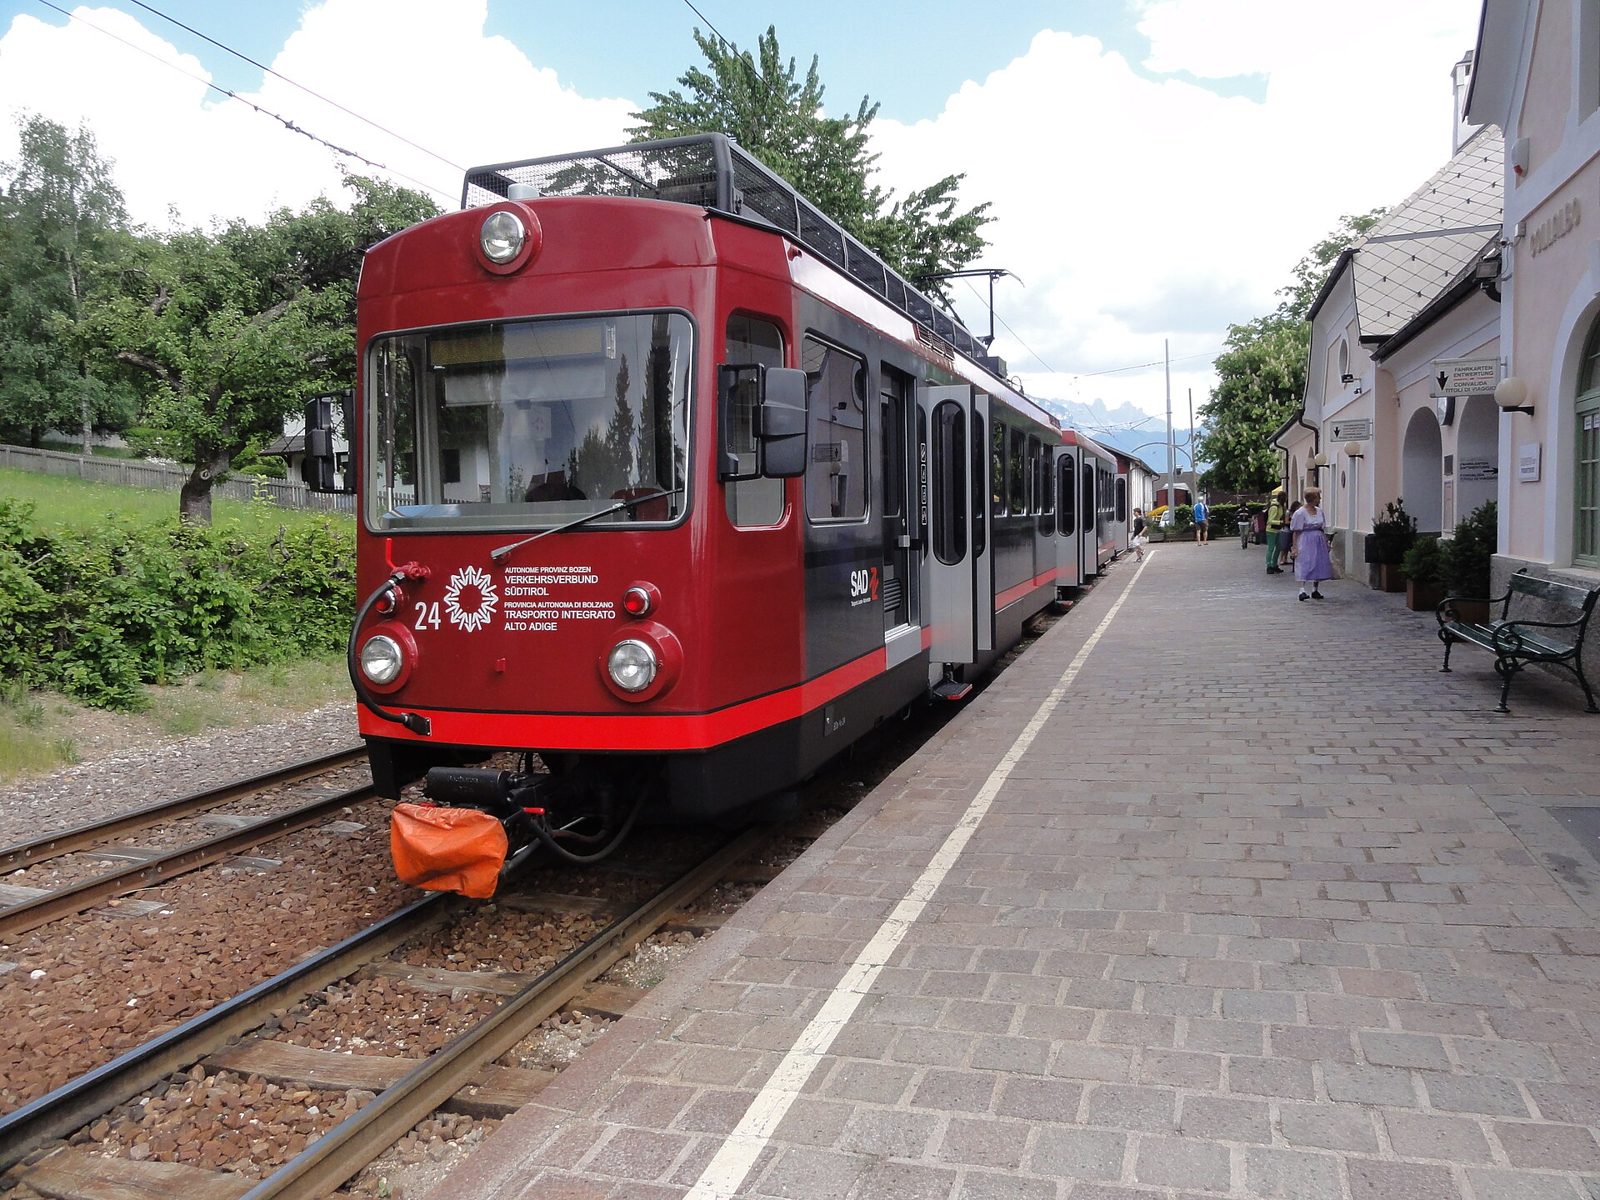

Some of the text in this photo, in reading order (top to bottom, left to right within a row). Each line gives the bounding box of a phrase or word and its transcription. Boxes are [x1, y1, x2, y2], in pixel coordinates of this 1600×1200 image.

[504, 566, 538, 574] AUTONOME
[540, 566, 568, 574] PROVINZ
[504, 575, 599, 584] VERKEHRSVERBUND
[850, 569, 869, 597] SAD
[504, 586, 550, 596] SÜDTIROL
[503, 601, 614, 609] PROVINCIA AUTONOMA DI BOLZANO
[414, 602, 442, 631] 24
[504, 610, 616, 619] TRASPORTO INTEGRATO
[504, 622, 558, 631] ALTO ADIGE
